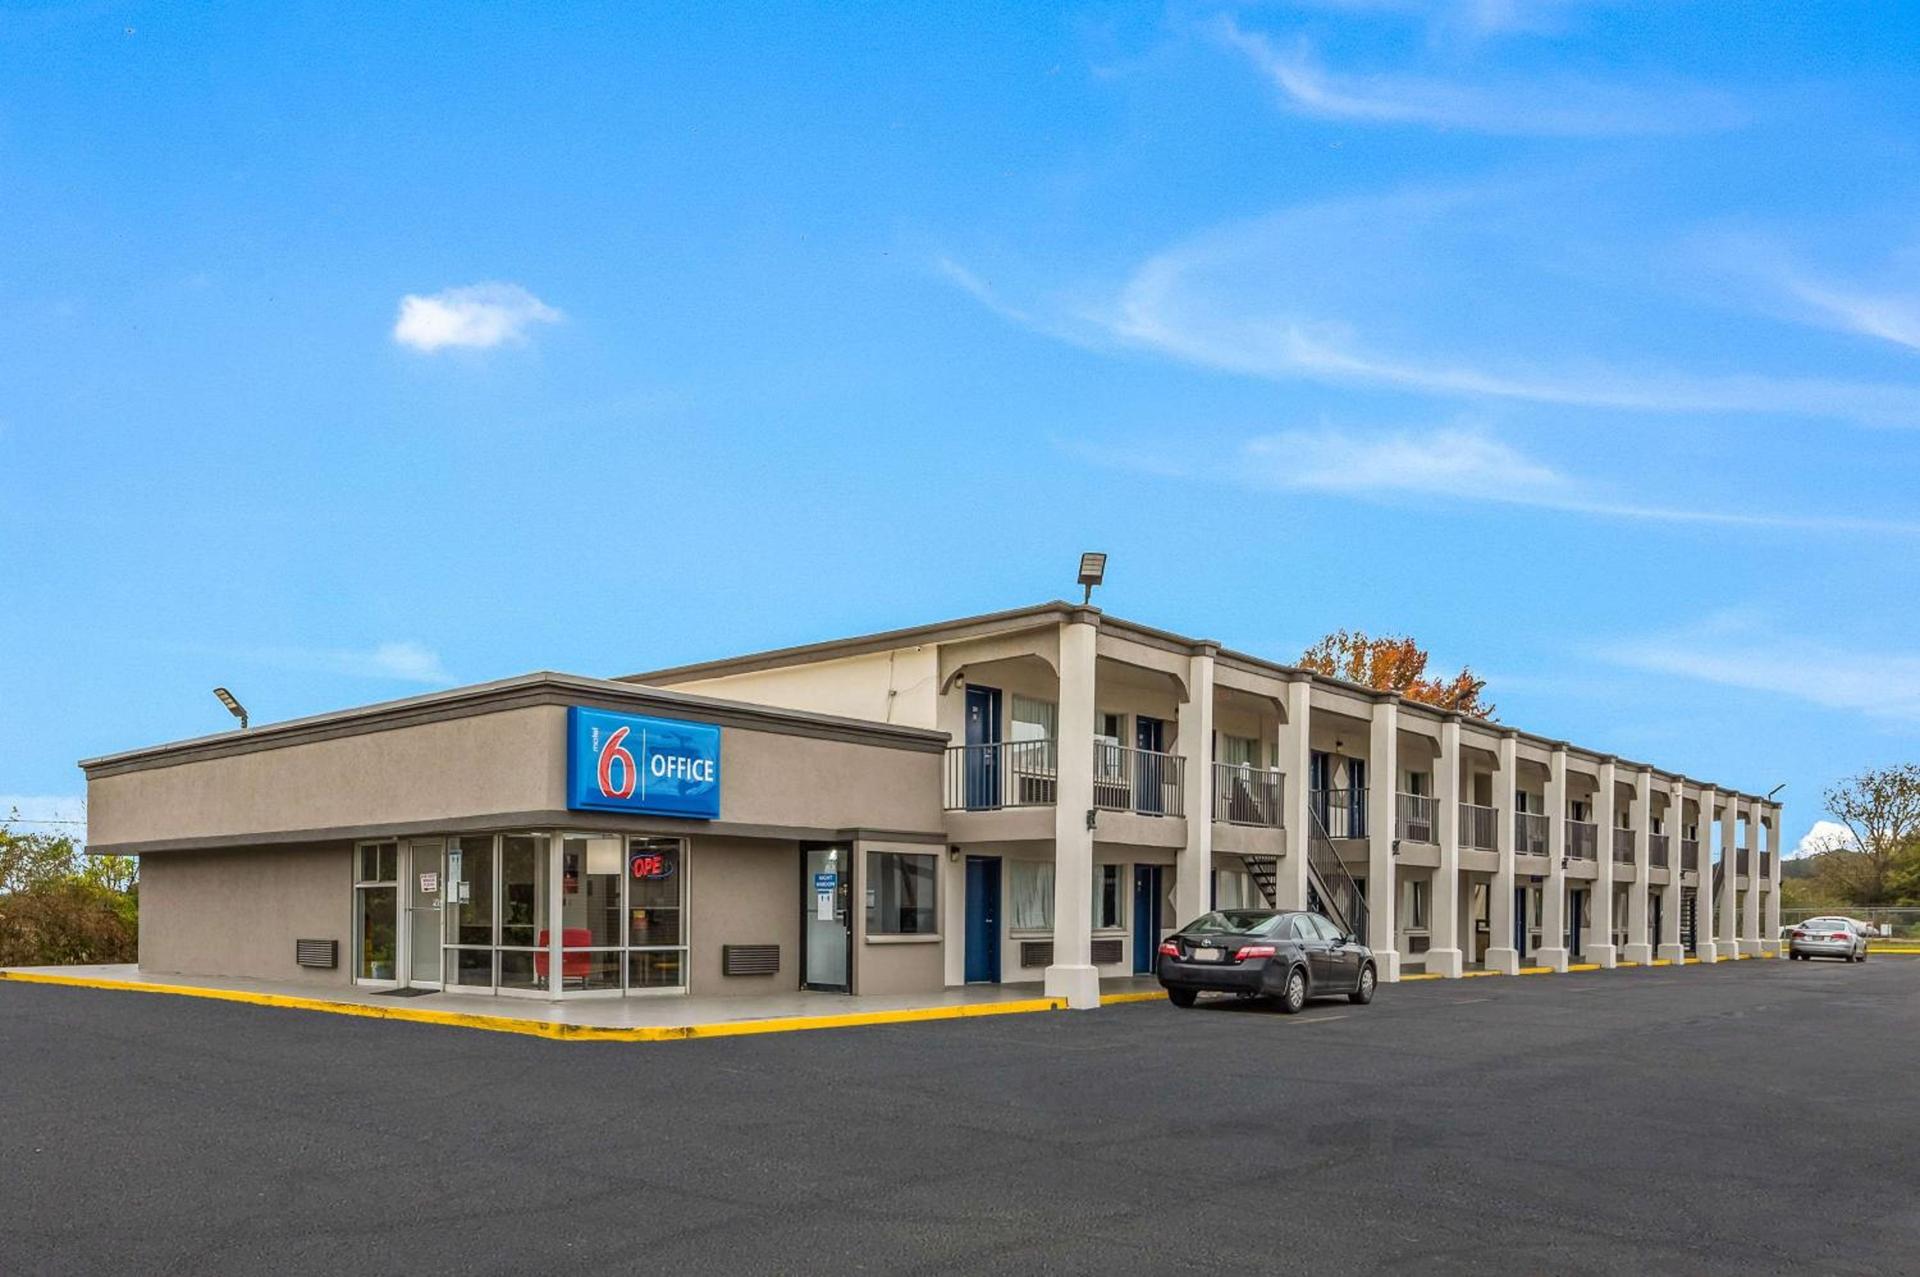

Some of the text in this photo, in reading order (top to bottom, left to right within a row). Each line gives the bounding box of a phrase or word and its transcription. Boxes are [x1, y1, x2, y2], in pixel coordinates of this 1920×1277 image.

[591, 726, 637, 800] motel 6
[651, 754, 714, 782] OFFICE
